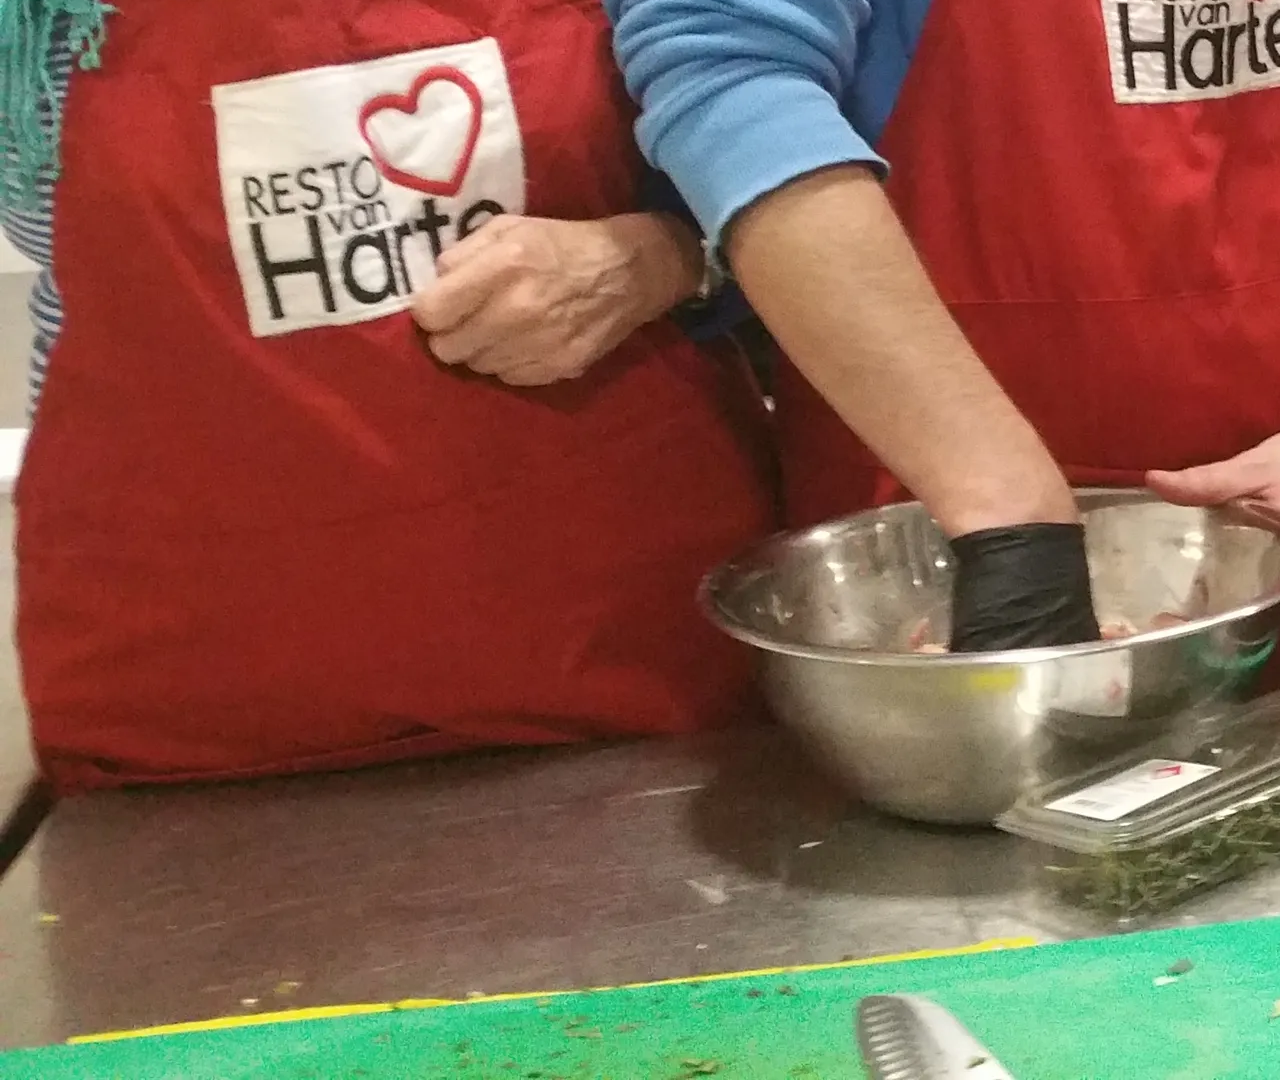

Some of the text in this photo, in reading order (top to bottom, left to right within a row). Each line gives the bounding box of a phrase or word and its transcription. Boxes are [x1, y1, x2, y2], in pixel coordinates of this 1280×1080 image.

[1180, 2, 1231, 27] van
[242, 156, 382, 217] RESTO
[326, 200, 391, 235] van
